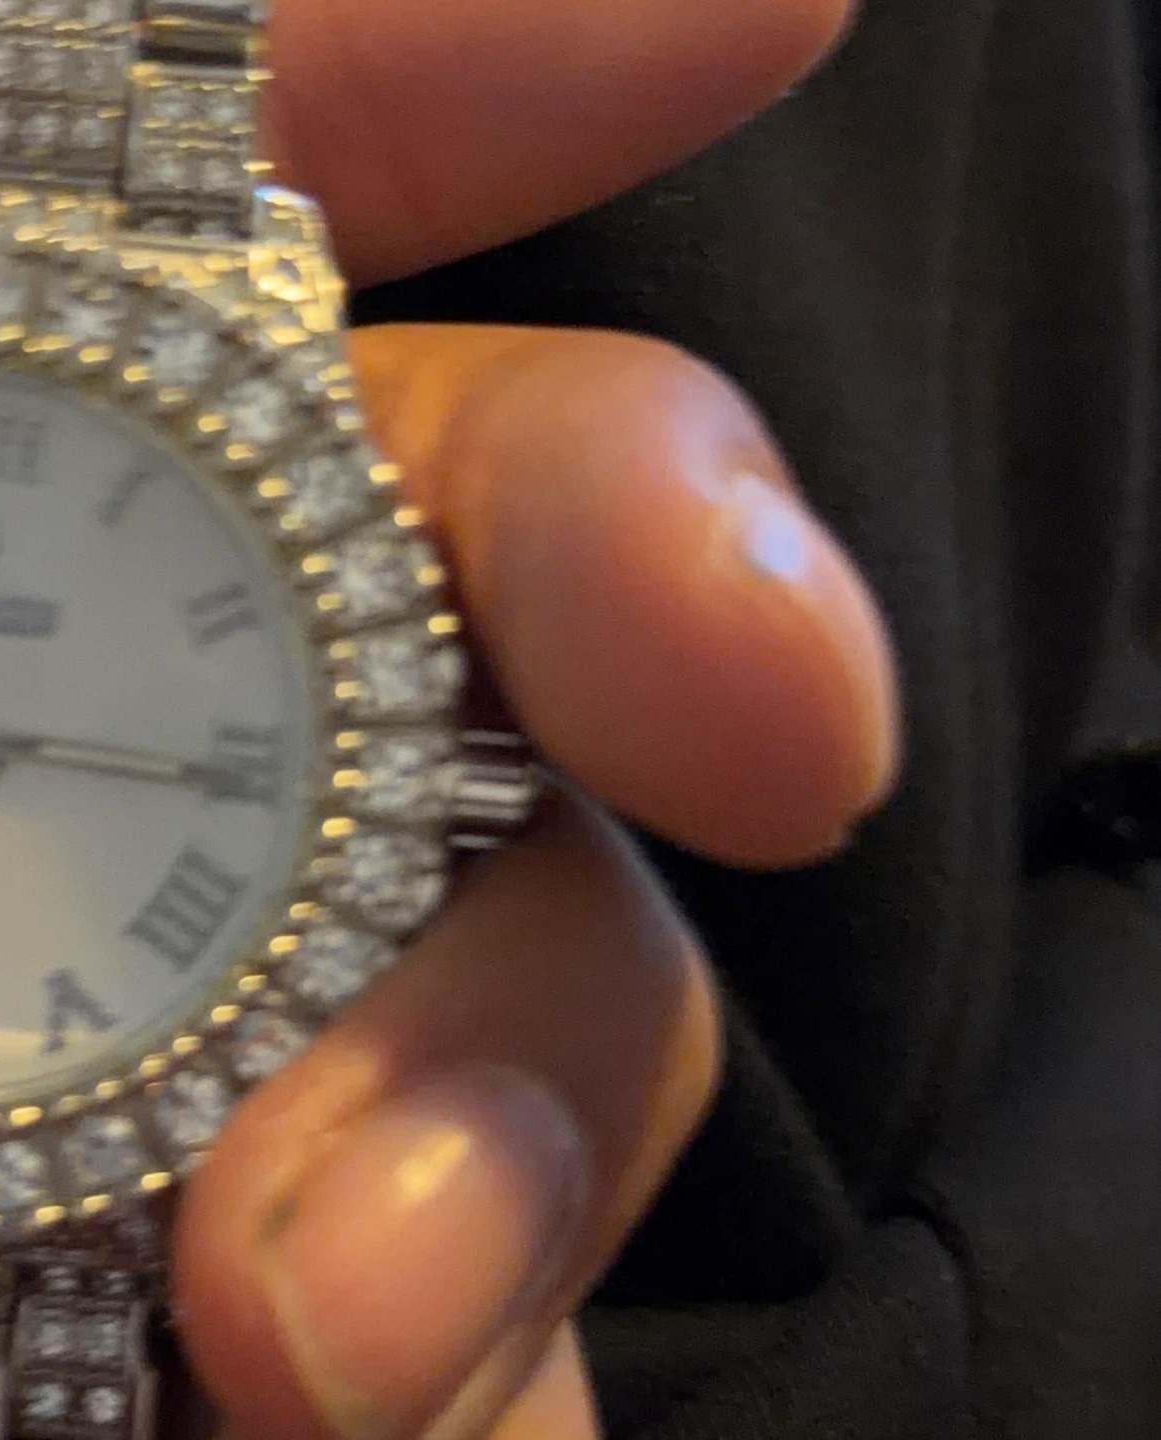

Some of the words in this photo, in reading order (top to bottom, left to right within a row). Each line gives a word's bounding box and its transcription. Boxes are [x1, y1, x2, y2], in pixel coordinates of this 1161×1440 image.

[182, 580, 262, 648] II
[124, 844, 250, 974] IIII
[42, 966, 122, 1054] V
